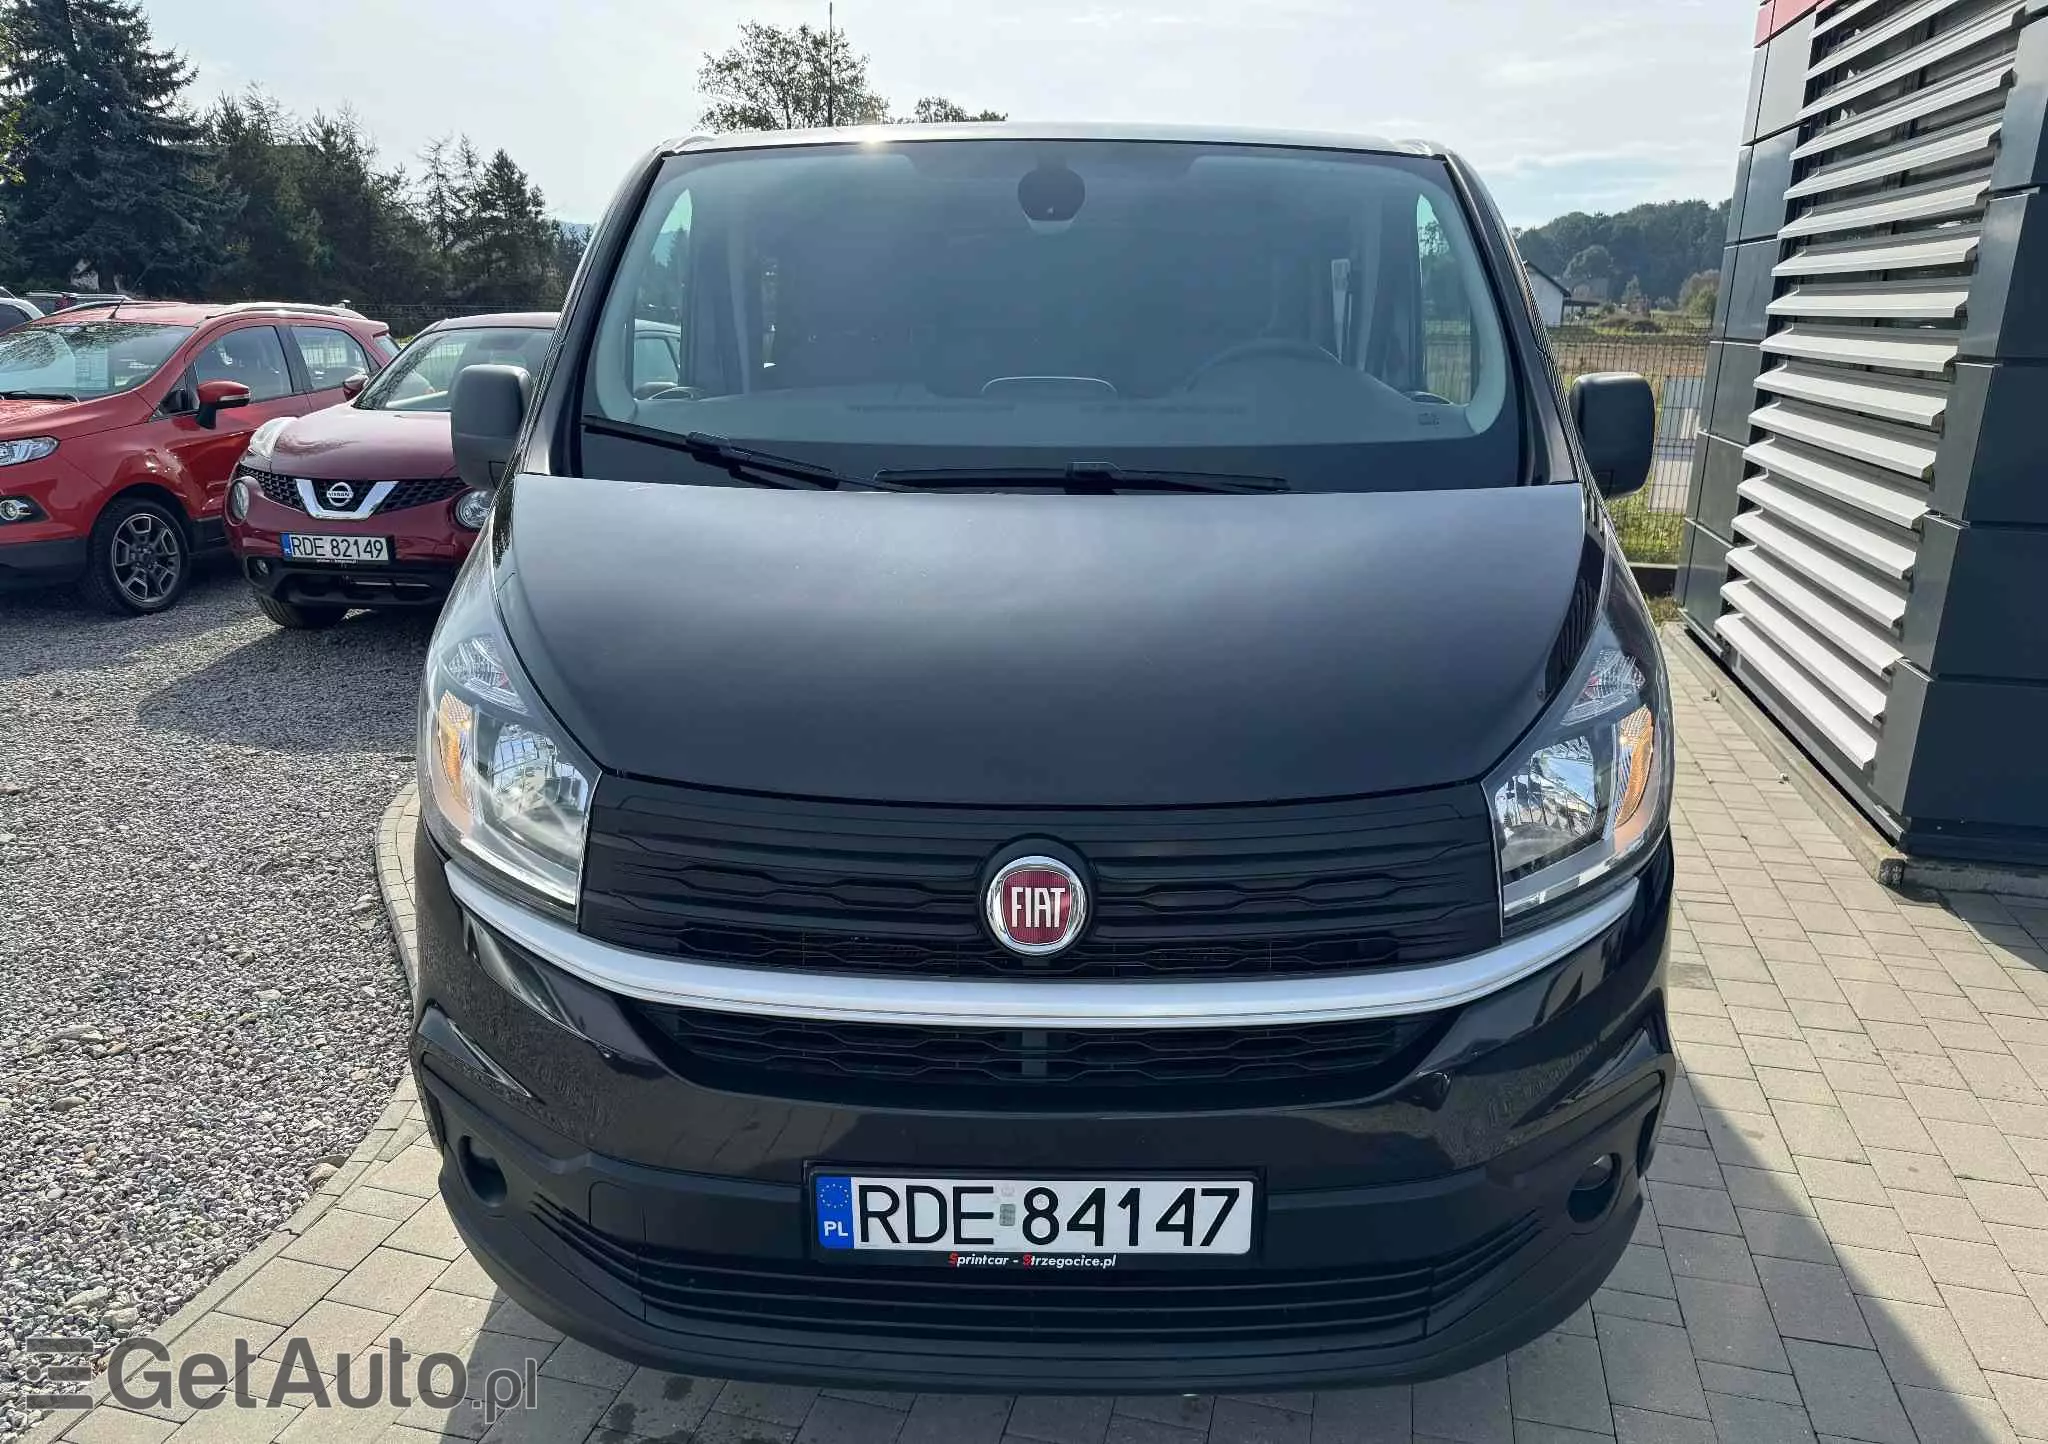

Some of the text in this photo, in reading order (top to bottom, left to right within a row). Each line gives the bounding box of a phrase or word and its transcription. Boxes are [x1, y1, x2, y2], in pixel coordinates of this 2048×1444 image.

[291, 536, 384, 559] RDE 82149
[1011, 886, 1066, 928] FIAT
[857, 1184, 1241, 1248] RDE 84147
[823, 1221, 849, 1237] PL
[949, 1252, 1009, 1267] Sprintcar
[1022, 1253, 1117, 1269] Strzegocice.pl
